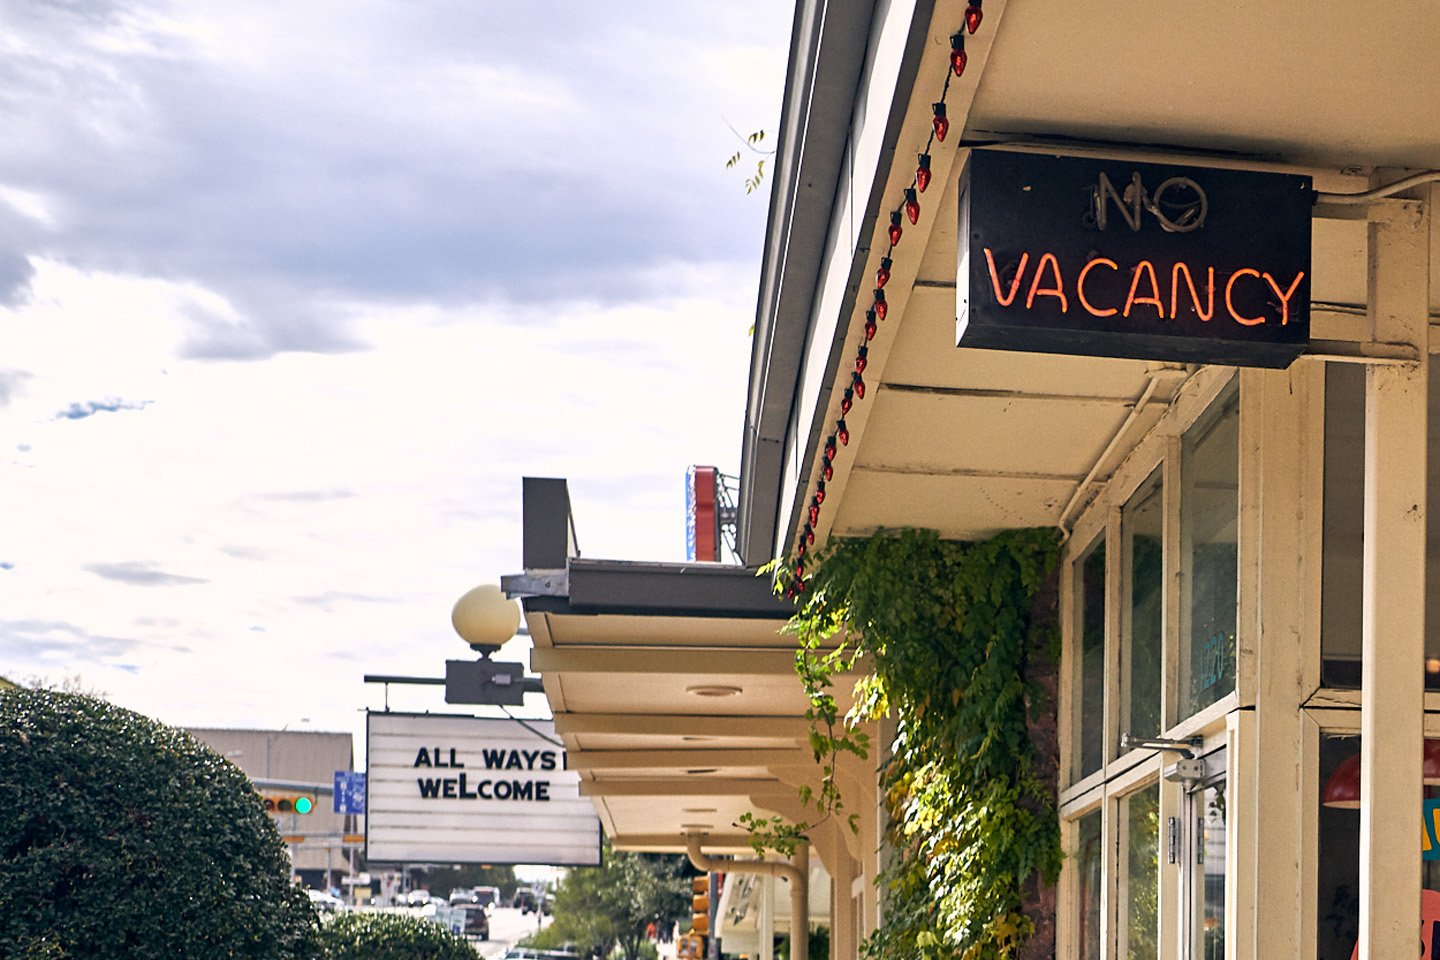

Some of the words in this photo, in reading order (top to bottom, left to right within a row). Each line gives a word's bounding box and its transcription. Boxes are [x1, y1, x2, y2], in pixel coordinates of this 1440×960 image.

[1095, 171, 1208, 233] NO
[983, 247, 1304, 326] VACANCY
[414, 747, 464, 768] ALL
[482, 749, 556, 770] WAYS
[417, 772, 550, 801] WELCOME
